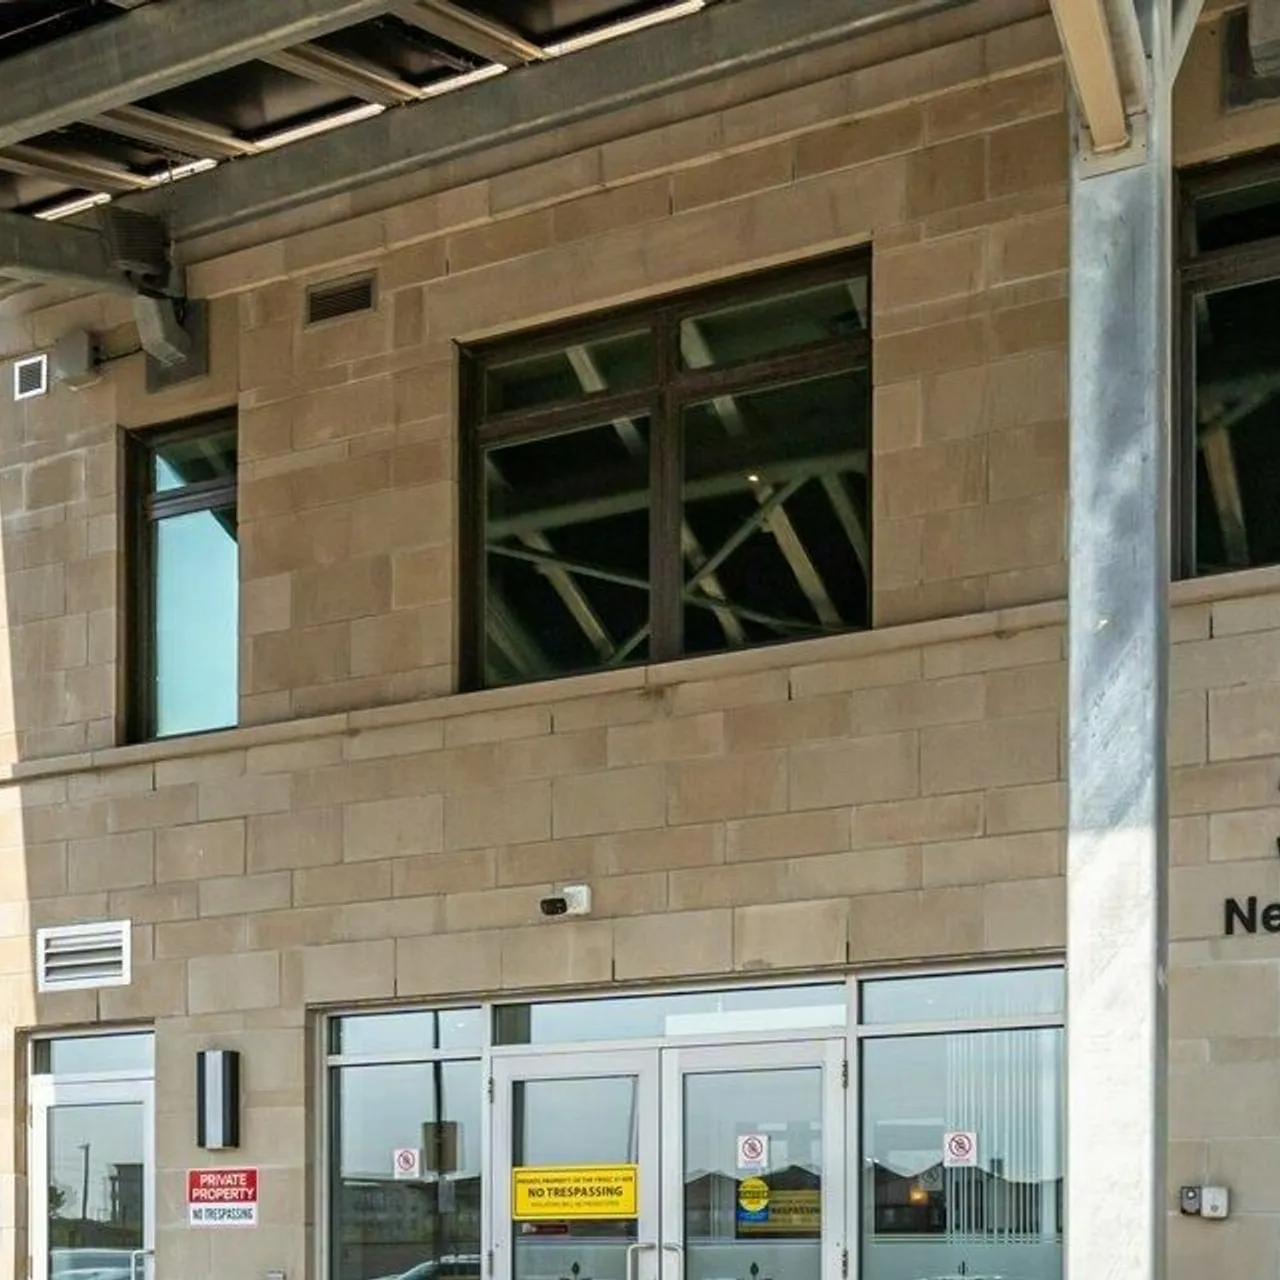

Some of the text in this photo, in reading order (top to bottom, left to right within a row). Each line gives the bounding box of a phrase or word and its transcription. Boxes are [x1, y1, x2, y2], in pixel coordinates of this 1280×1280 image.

[200, 1173, 247, 1187] PRIVATE
[192, 1187, 255, 1200] PROPERTY
[528, 1185, 624, 1198] NO TRESPASSING
[192, 1206, 254, 1220] NO TRESPASSING
